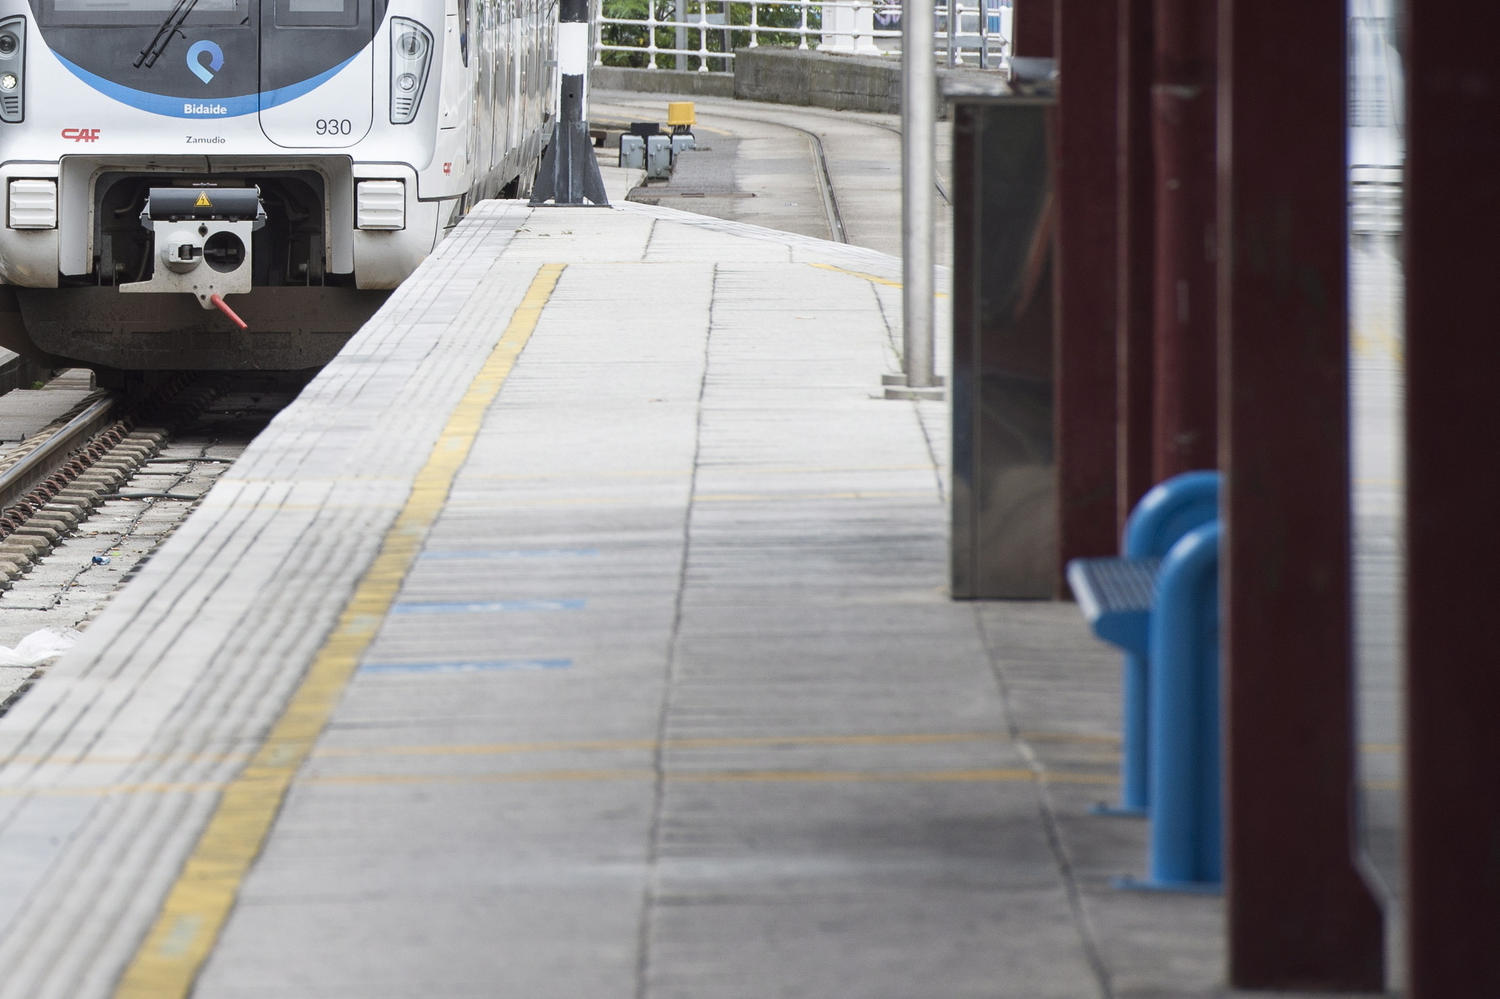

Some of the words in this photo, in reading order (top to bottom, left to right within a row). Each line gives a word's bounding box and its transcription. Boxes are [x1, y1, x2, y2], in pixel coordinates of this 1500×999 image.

[183, 103, 228, 115] Bidaide
[315, 118, 352, 136] 930
[61, 128, 100, 142] CAF
[185, 135, 226, 144] Zamudio
